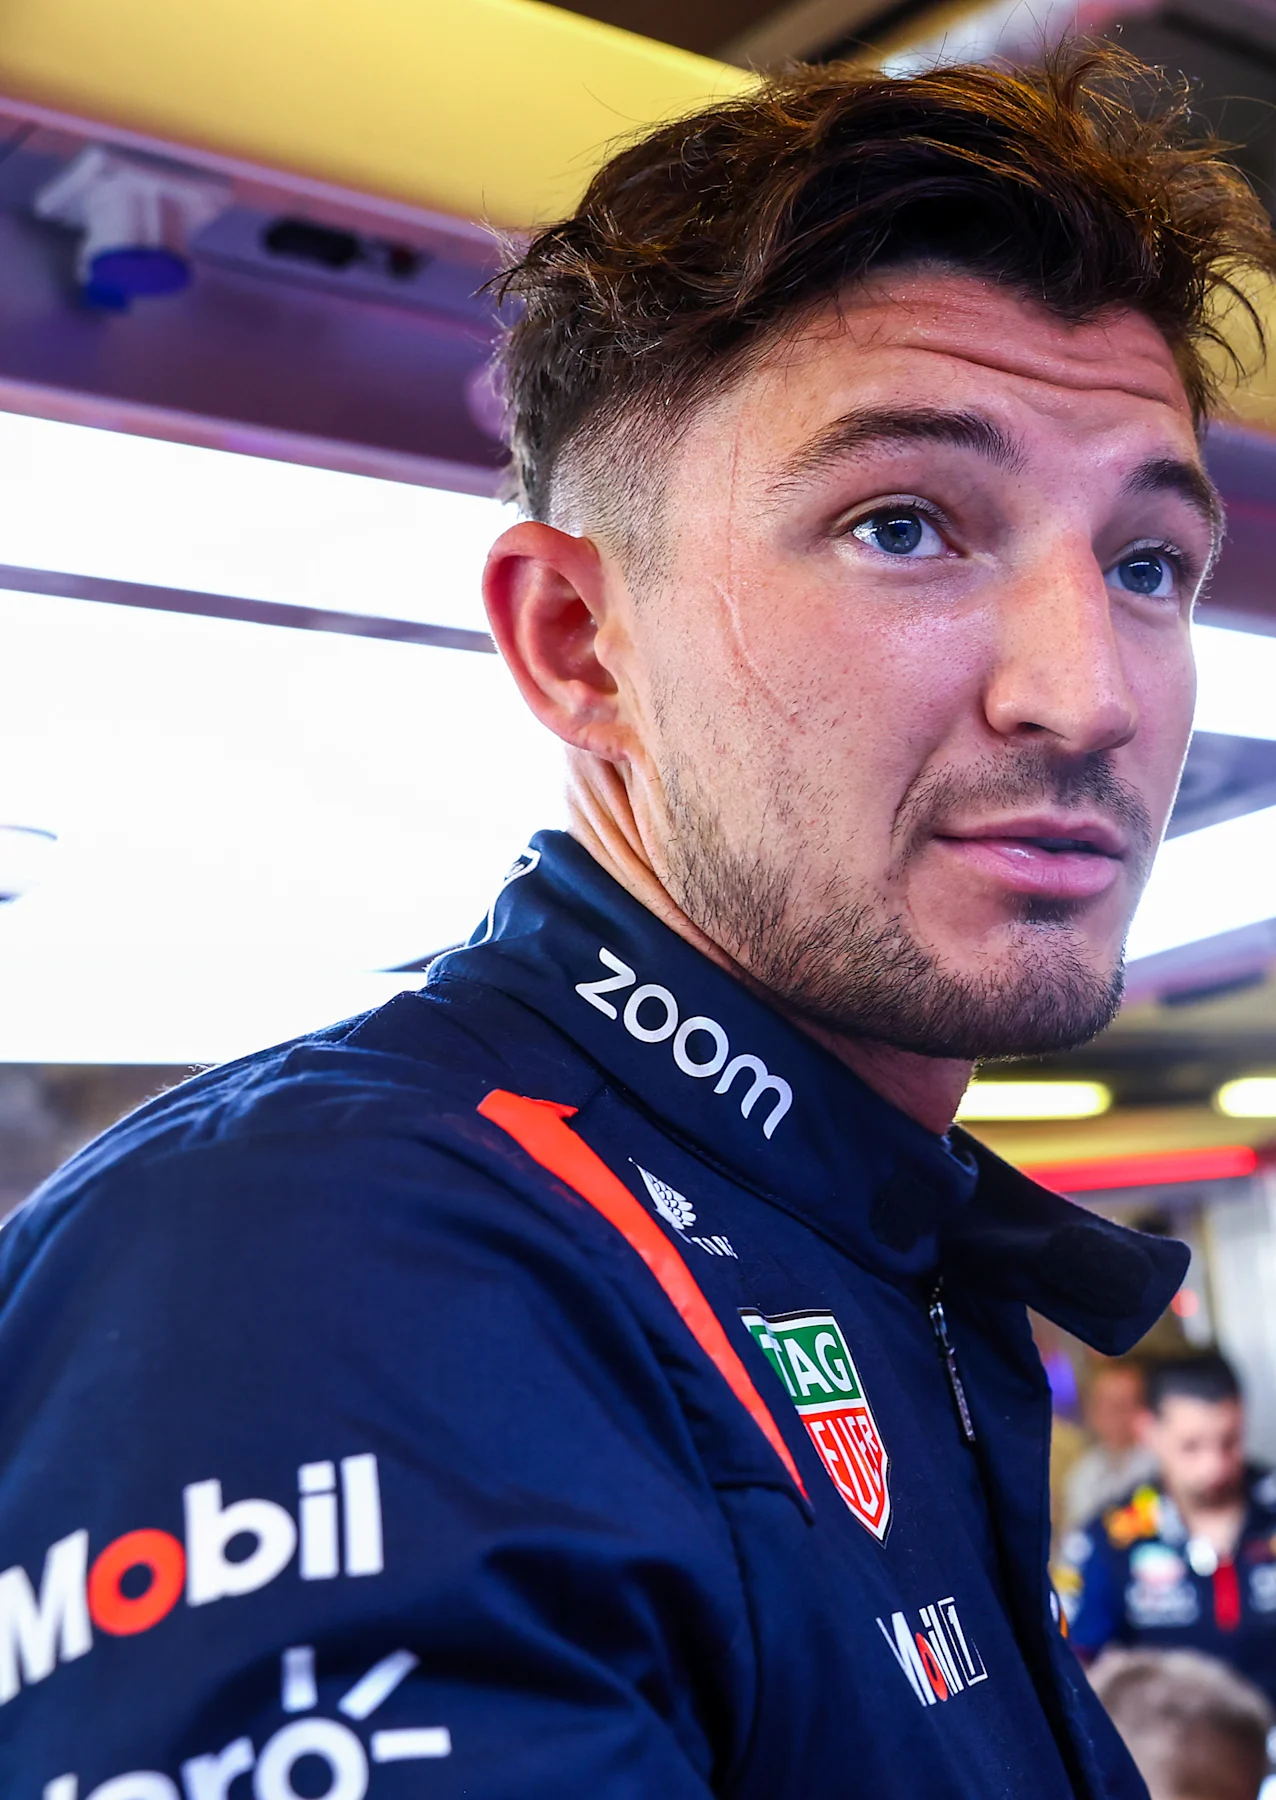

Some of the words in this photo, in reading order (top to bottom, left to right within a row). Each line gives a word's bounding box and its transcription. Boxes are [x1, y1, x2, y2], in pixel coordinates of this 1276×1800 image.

[574, 946, 793, 1140] zoom
[758, 1331, 854, 1397] TAG
[808, 1414, 882, 1518] EUER
[0, 1453, 384, 1706] Mobil
[876, 1604, 964, 1707] Moil
